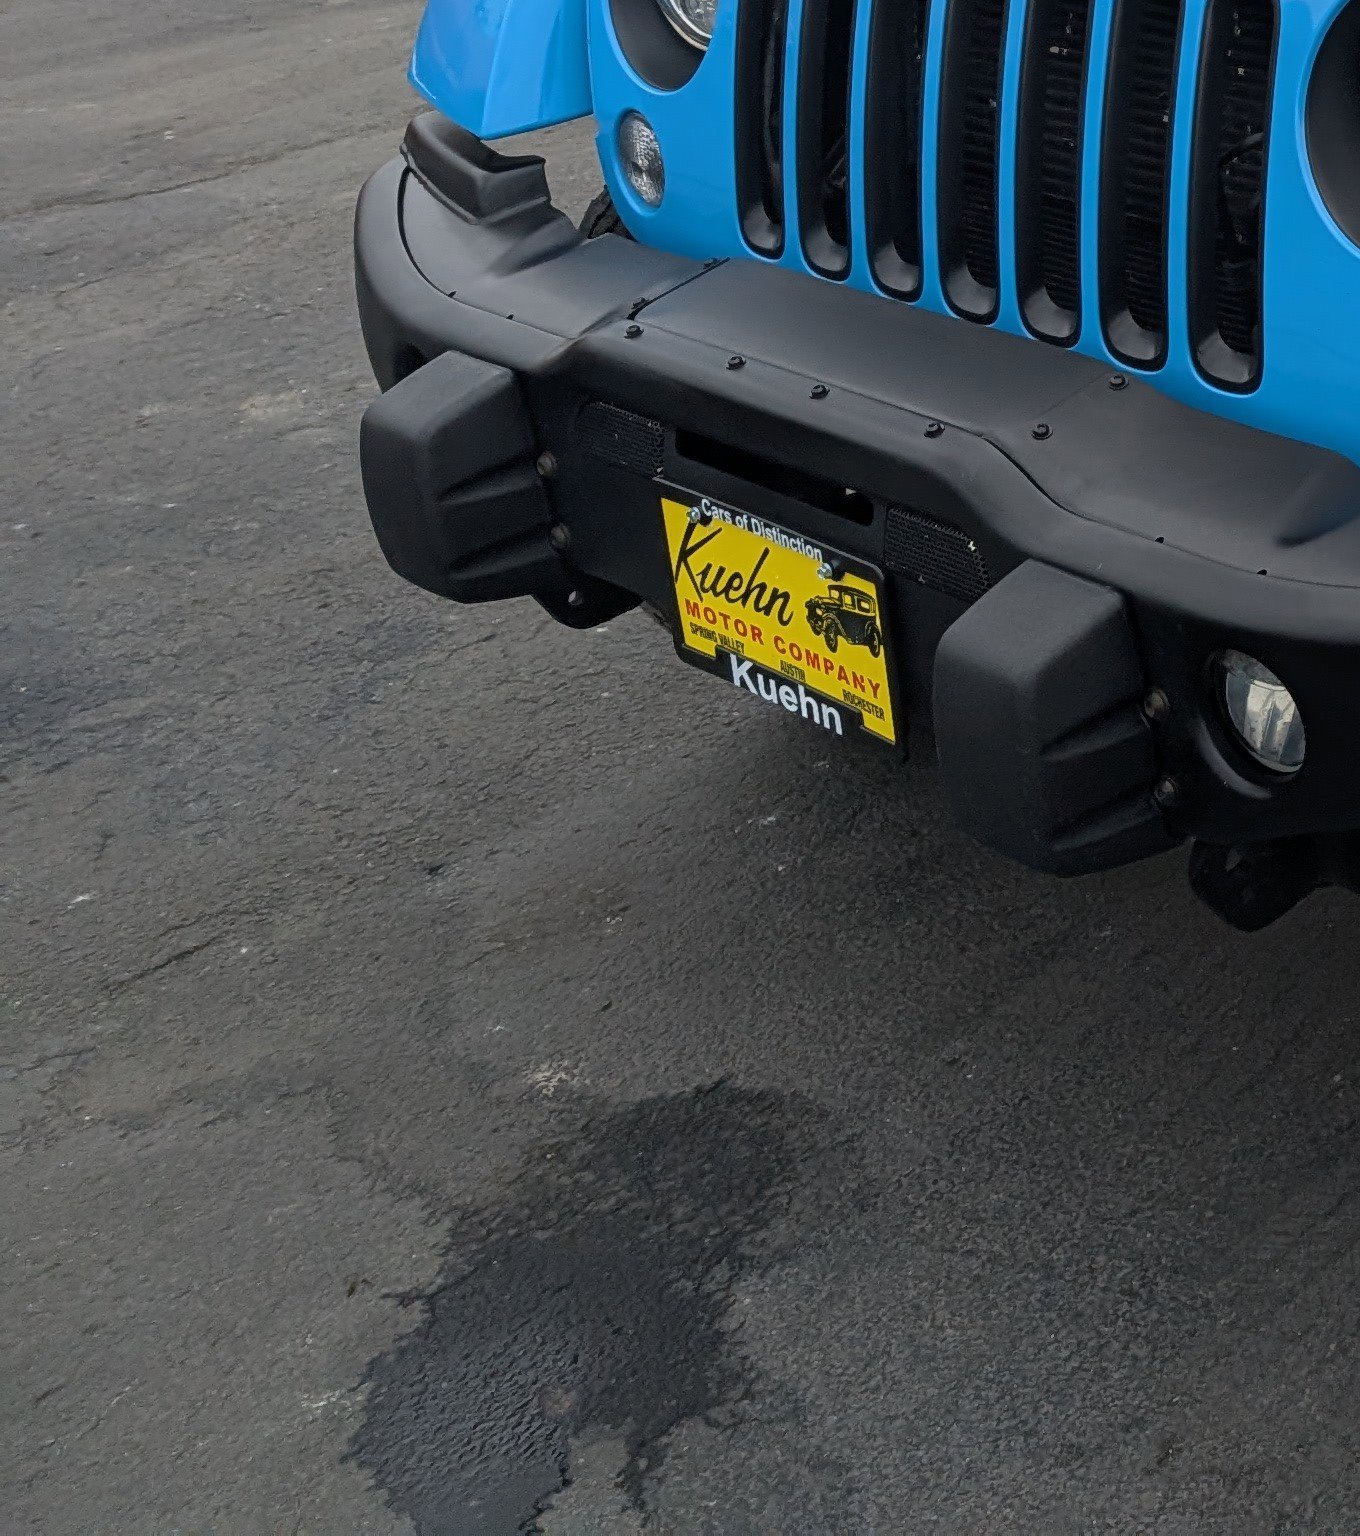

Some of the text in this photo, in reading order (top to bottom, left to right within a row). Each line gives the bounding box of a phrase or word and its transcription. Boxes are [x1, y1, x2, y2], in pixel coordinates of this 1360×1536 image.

[701, 498, 823, 563] Cars of Distinction
[674, 519, 794, 627] Kuehn
[684, 598, 881, 700] MOTOR COMPANY
[730, 652, 843, 736] Kuehn
[842, 688, 886, 722] ROCHESTER
